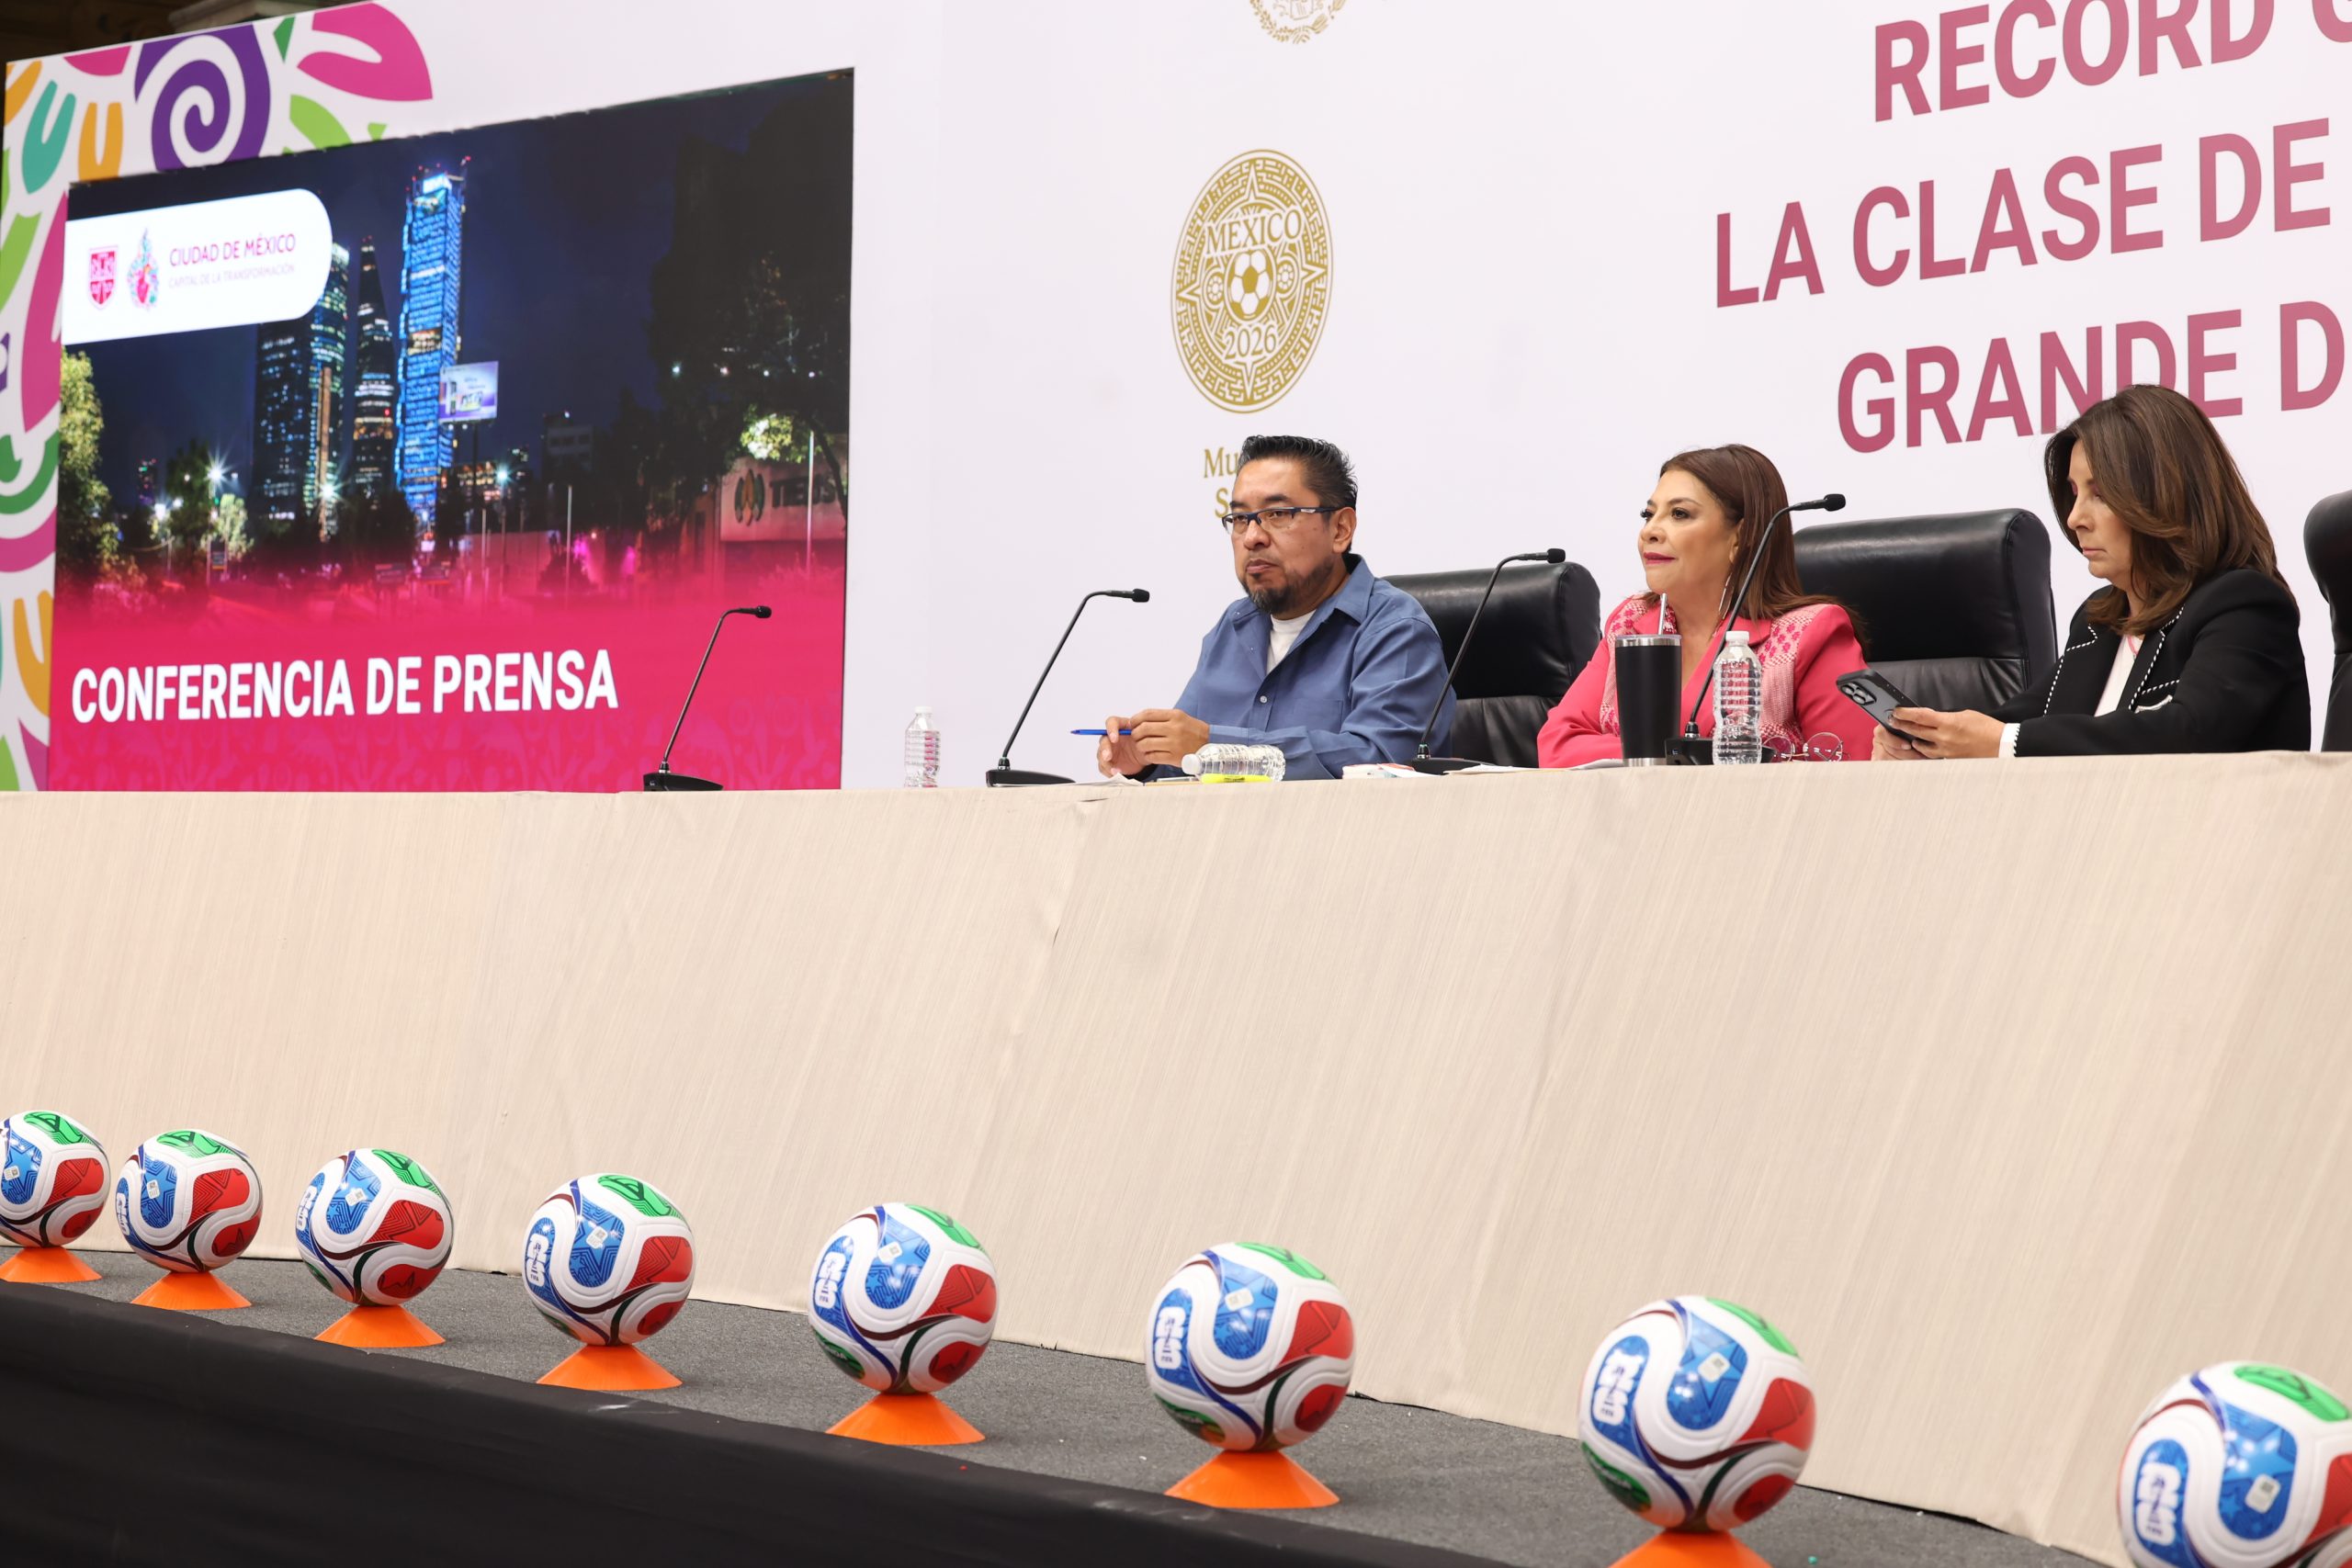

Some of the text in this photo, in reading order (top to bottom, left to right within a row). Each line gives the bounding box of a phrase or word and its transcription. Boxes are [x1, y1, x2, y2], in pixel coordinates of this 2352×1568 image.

[1875, 0, 2275, 122] RECORD
[169, 232, 296, 267] CIUDAD DE MÉXICO
[1717, 117, 2331, 308] LA CLASE DE
[1224, 324, 1277, 360] 2026
[1838, 309, 2244, 454] GRANDE
[72, 649, 618, 723] CONFERENCIA DE PRENSA
